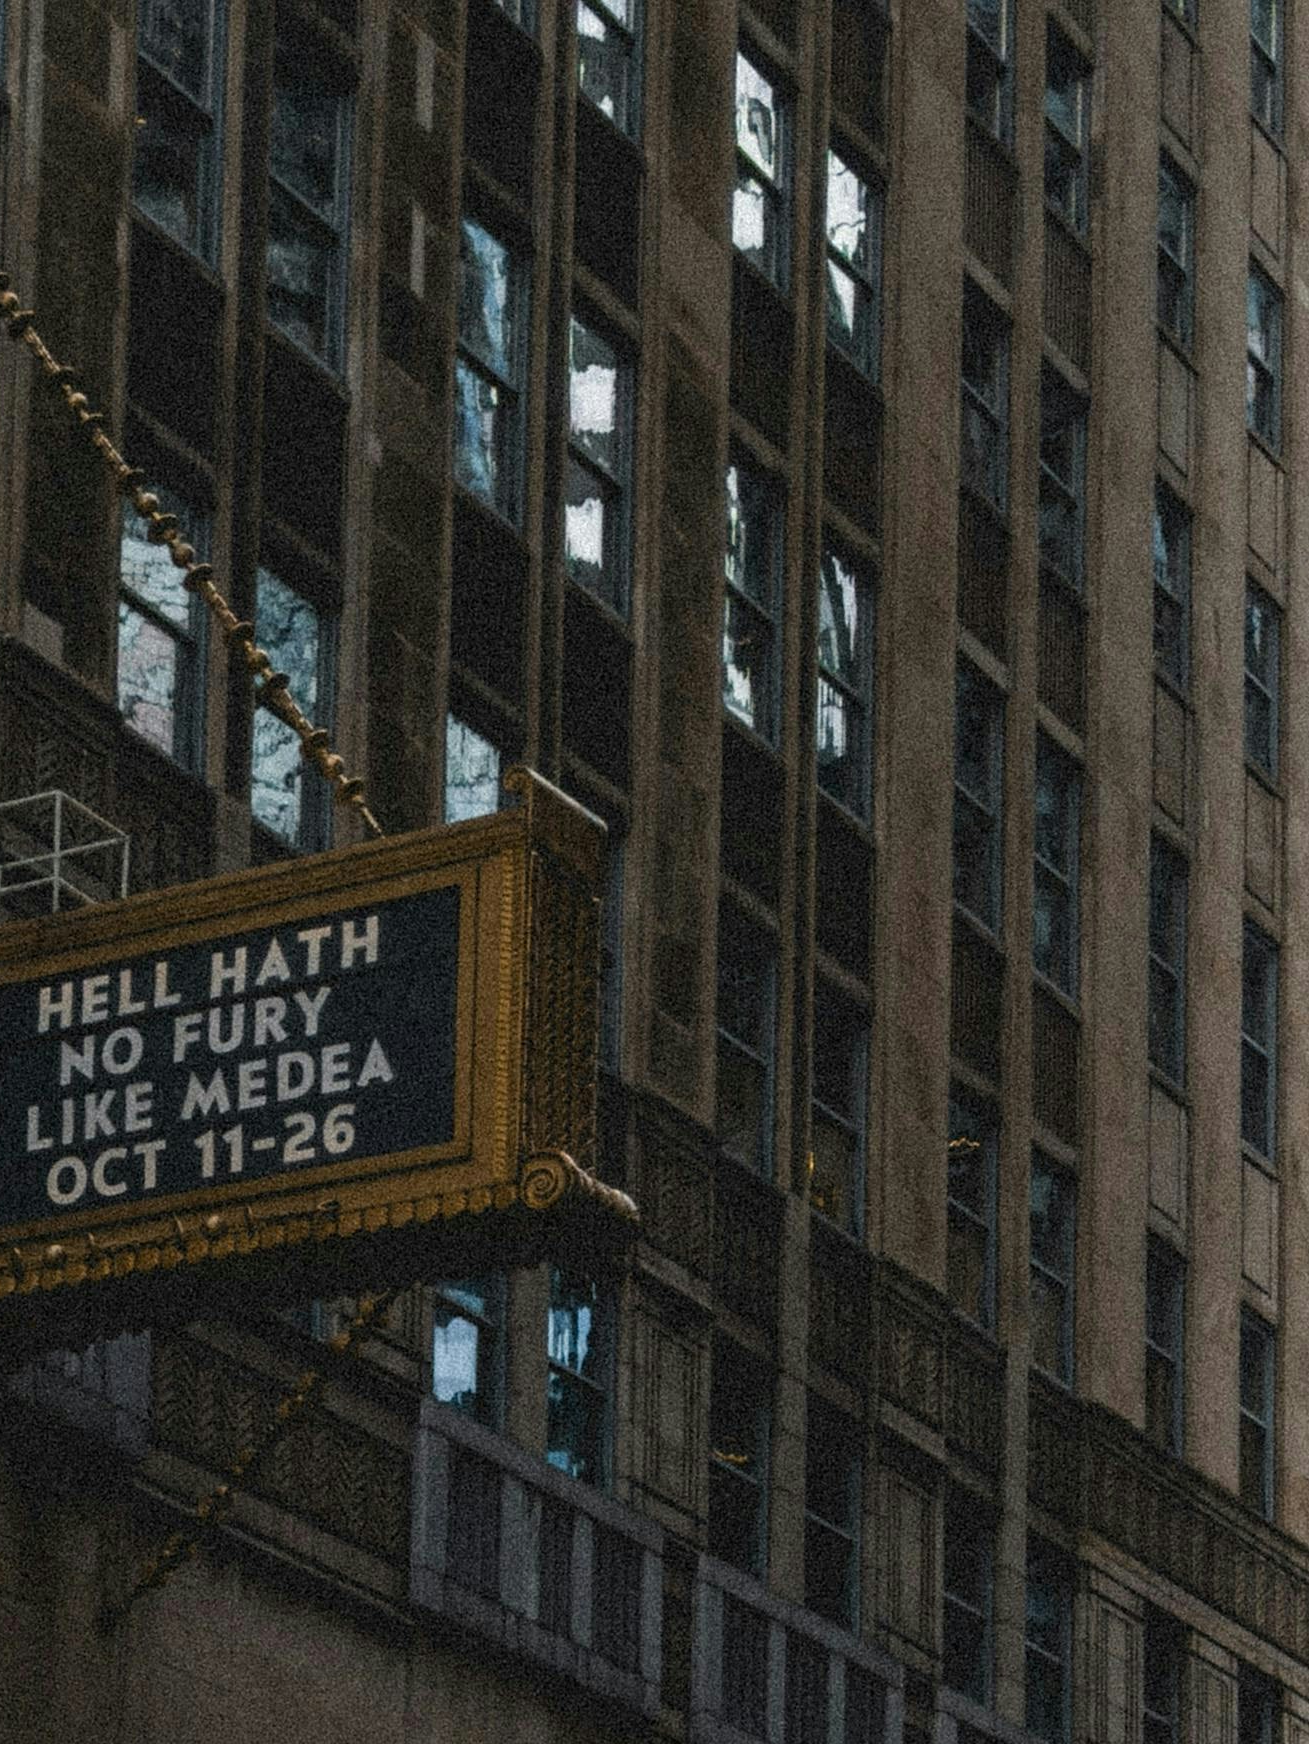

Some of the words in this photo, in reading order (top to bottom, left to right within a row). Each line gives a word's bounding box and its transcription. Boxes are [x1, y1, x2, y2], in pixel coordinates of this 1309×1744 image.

[37, 962, 182, 1033] HELL
[209, 914, 380, 998] HATH
[59, 1027, 144, 1087] NO
[172, 986, 332, 1063] FURY
[26, 1082, 153, 1152] LIKE
[180, 1038, 394, 1119] MEDEA
[47, 1140, 167, 1206] OCT
[194, 1104, 356, 1179] 11-26
